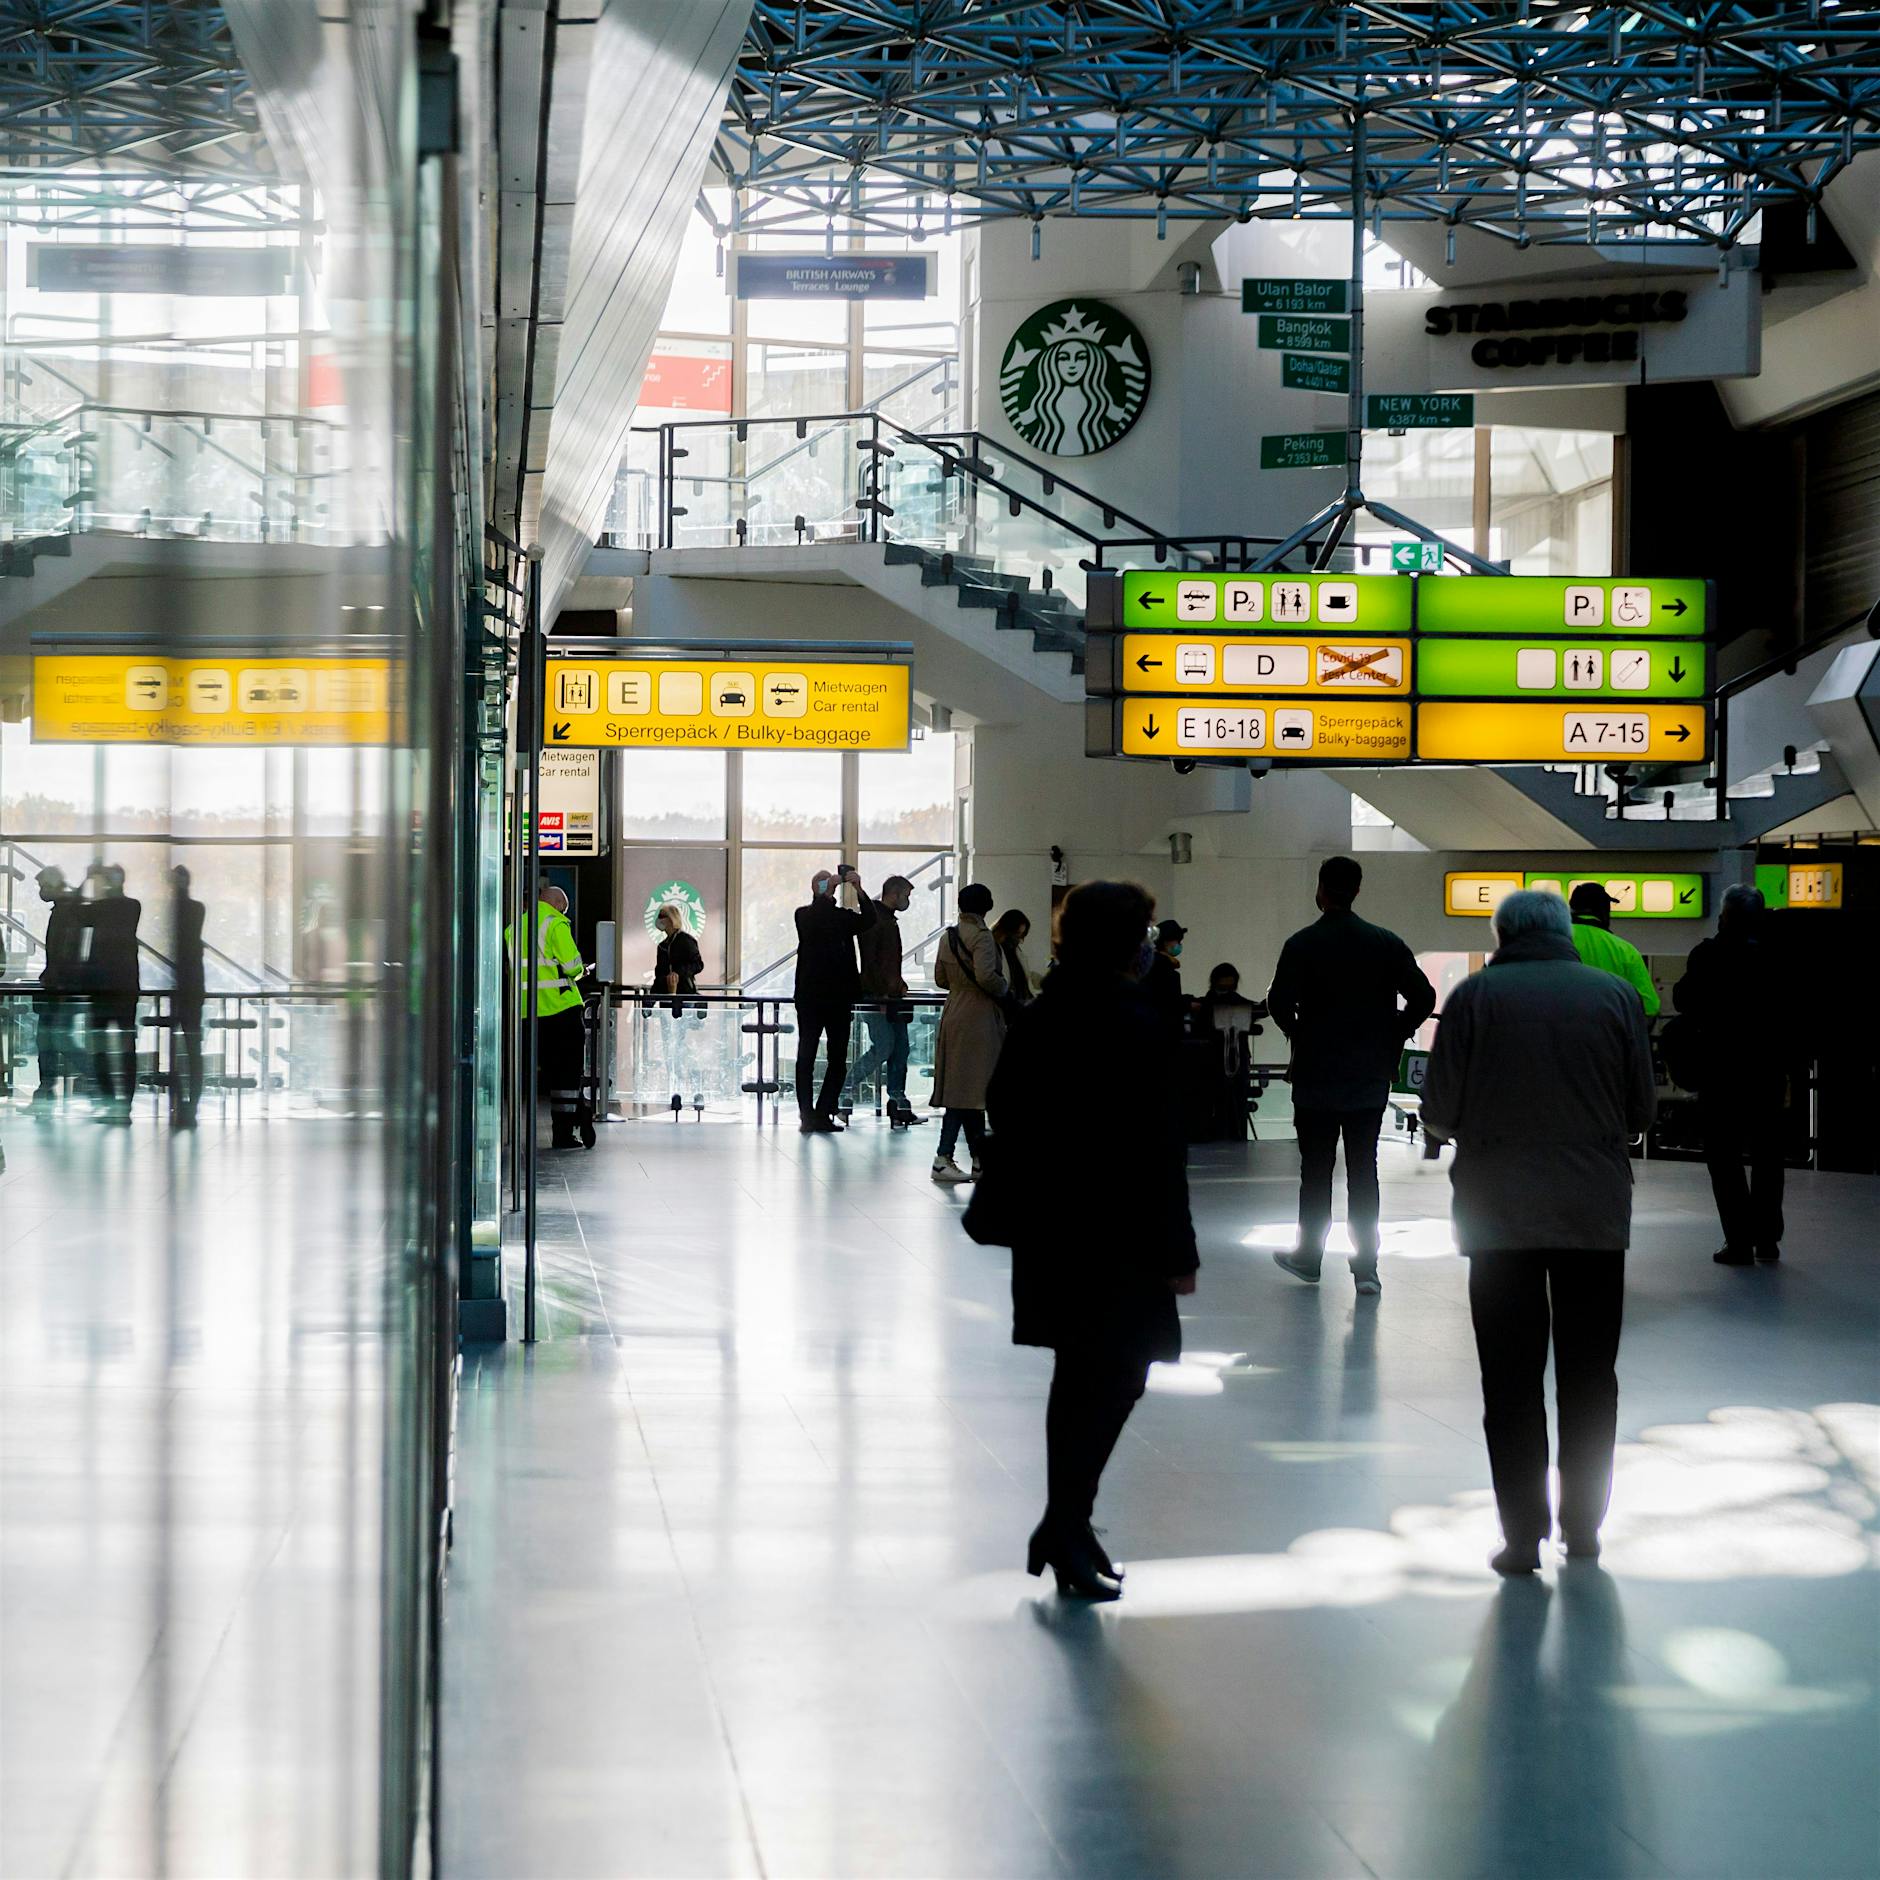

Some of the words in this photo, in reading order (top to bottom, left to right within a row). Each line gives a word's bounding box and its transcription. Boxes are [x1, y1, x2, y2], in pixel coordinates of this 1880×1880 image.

[786, 269, 829, 280] BRITISH
[830, 269, 876, 280] AIRWAYS
[792, 281, 830, 291] Terraces
[835, 282, 869, 292] Lounge
[1257, 282, 1289, 296] Ulan
[1294, 282, 1333, 296] Bator
[1307, 300, 1326, 310] km
[1425, 290, 1688, 335] STARBUCKS
[1276, 319, 1332, 338] Bangkok
[1314, 338, 1331, 349] km
[1471, 331, 1638, 368] COFFEE
[1379, 398, 1411, 411] NEW
[1420, 398, 1461, 411] YORK
[1388, 414, 1416, 425] 6387
[1419, 414, 1438, 424] km
[1284, 437, 1325, 451] Peking
[1287, 452, 1311, 464] 7353
[1313, 452, 1329, 463] km
[1322, 651, 1372, 664] Covid-19
[1257, 655, 1275, 675] D
[1322, 668, 1346, 681] Test
[1349, 669, 1389, 681] Center
[621, 681, 639, 704] E
[813, 681, 888, 696] Mietwagen
[813, 700, 838, 713] Car
[841, 700, 880, 713] rental
[1184, 717, 1196, 738] E
[1204, 718, 1260, 740] 16-18
[1319, 714, 1404, 731] Sperrgepäck
[605, 722, 719, 742] Sperrgepäck
[737, 724, 872, 745] Bulky-baggage
[1570, 722, 1588, 743] A
[1596, 722, 1645, 744] 7-15
[1318, 732, 1407, 749] Bulky-baggage
[538, 766, 556, 777] Car
[559, 766, 591, 777] rental
[540, 816, 561, 826] AVIS
[1478, 885, 1491, 903] E
